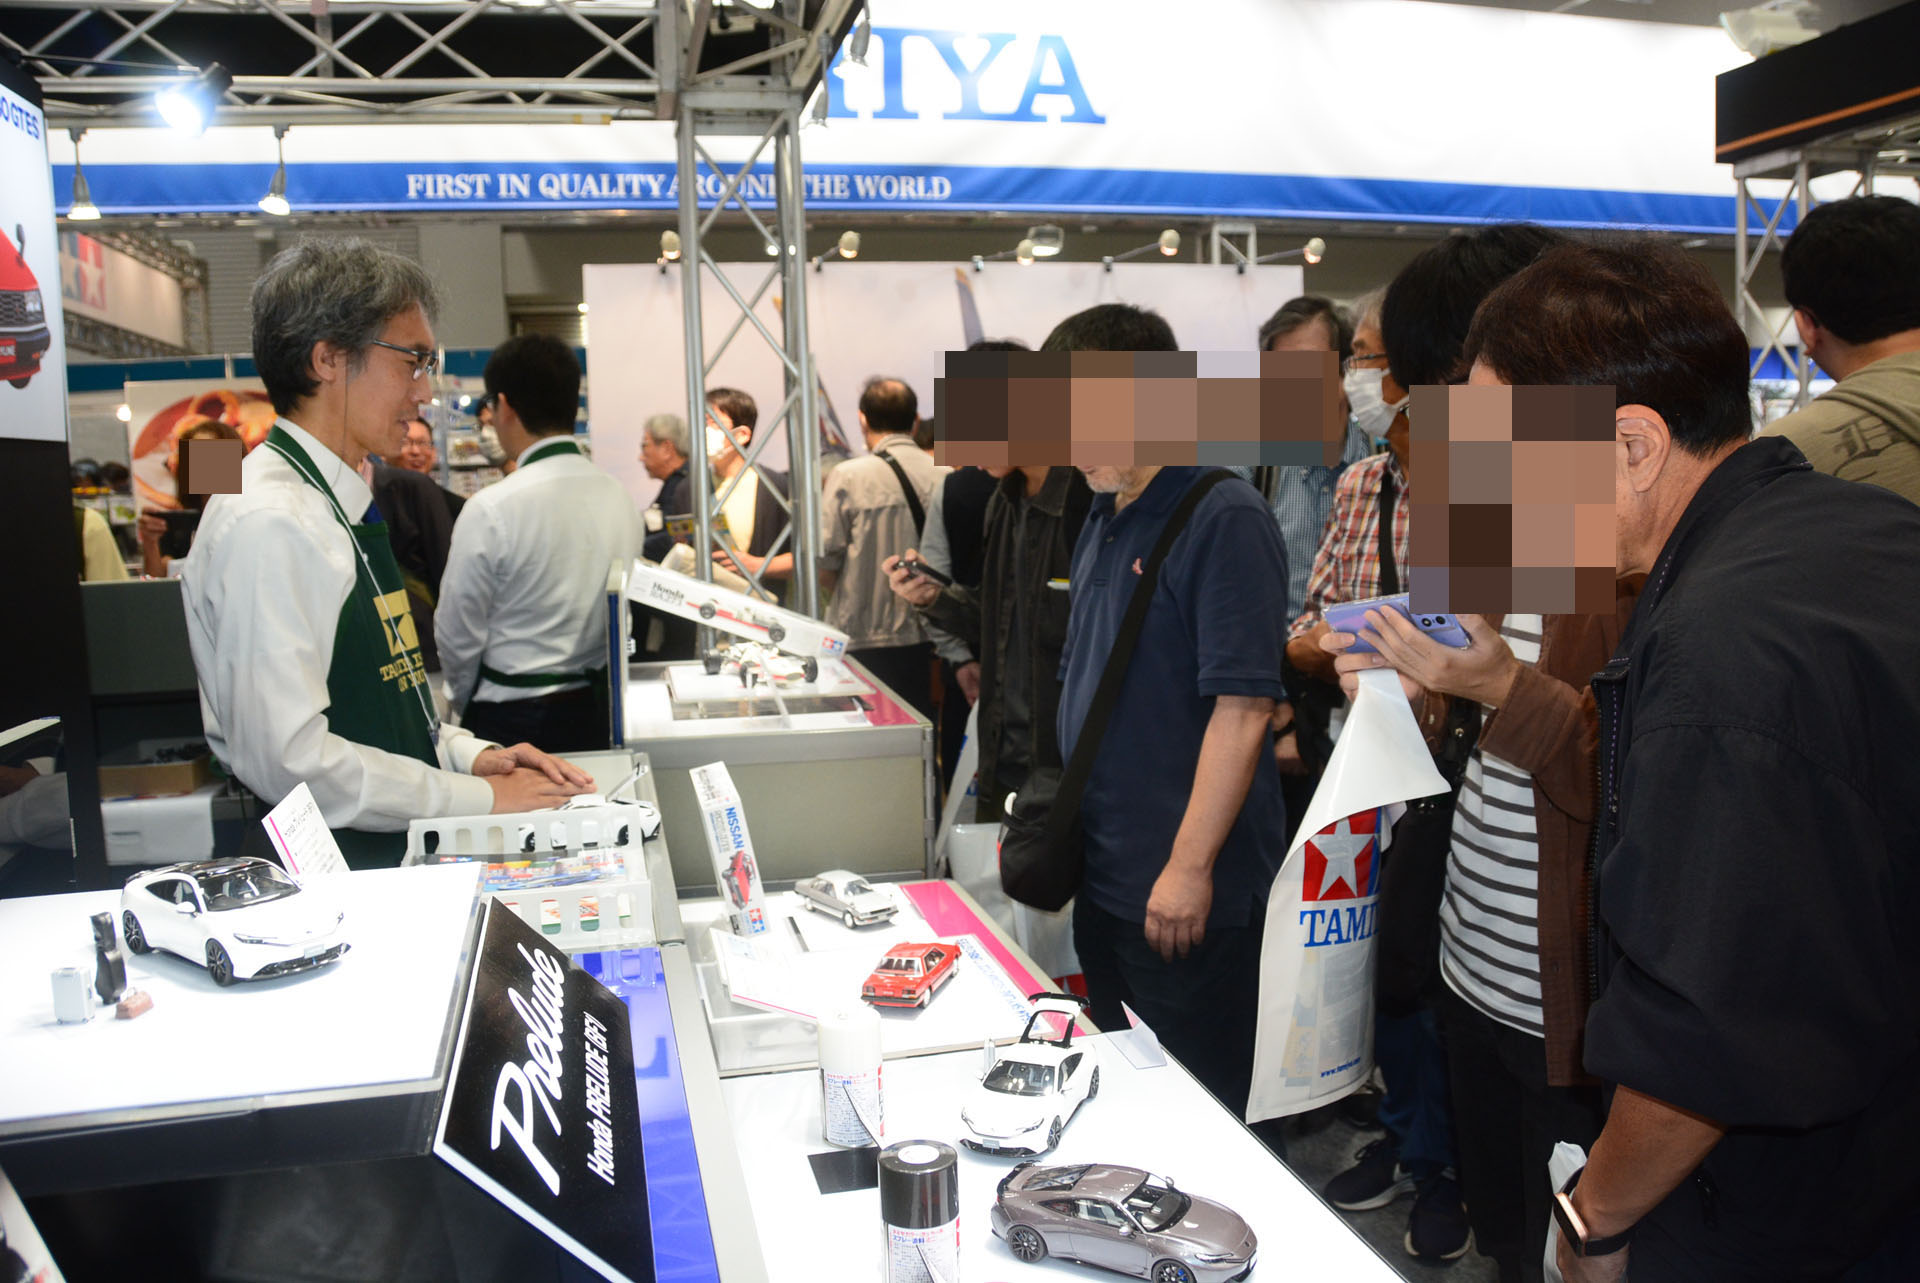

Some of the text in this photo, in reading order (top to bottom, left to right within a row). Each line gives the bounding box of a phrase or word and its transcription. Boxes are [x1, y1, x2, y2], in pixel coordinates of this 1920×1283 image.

[406, 173, 952, 200] FIRST IN QUALITY AROUN THE WORLD
[725, 806, 745, 850] NISSAN
[1299, 902, 1378, 948] TAMI
[490, 941, 564, 1197] Prelude
[585, 1041, 612, 1125] PRELUDE
[586, 1119, 616, 1186] Honda
